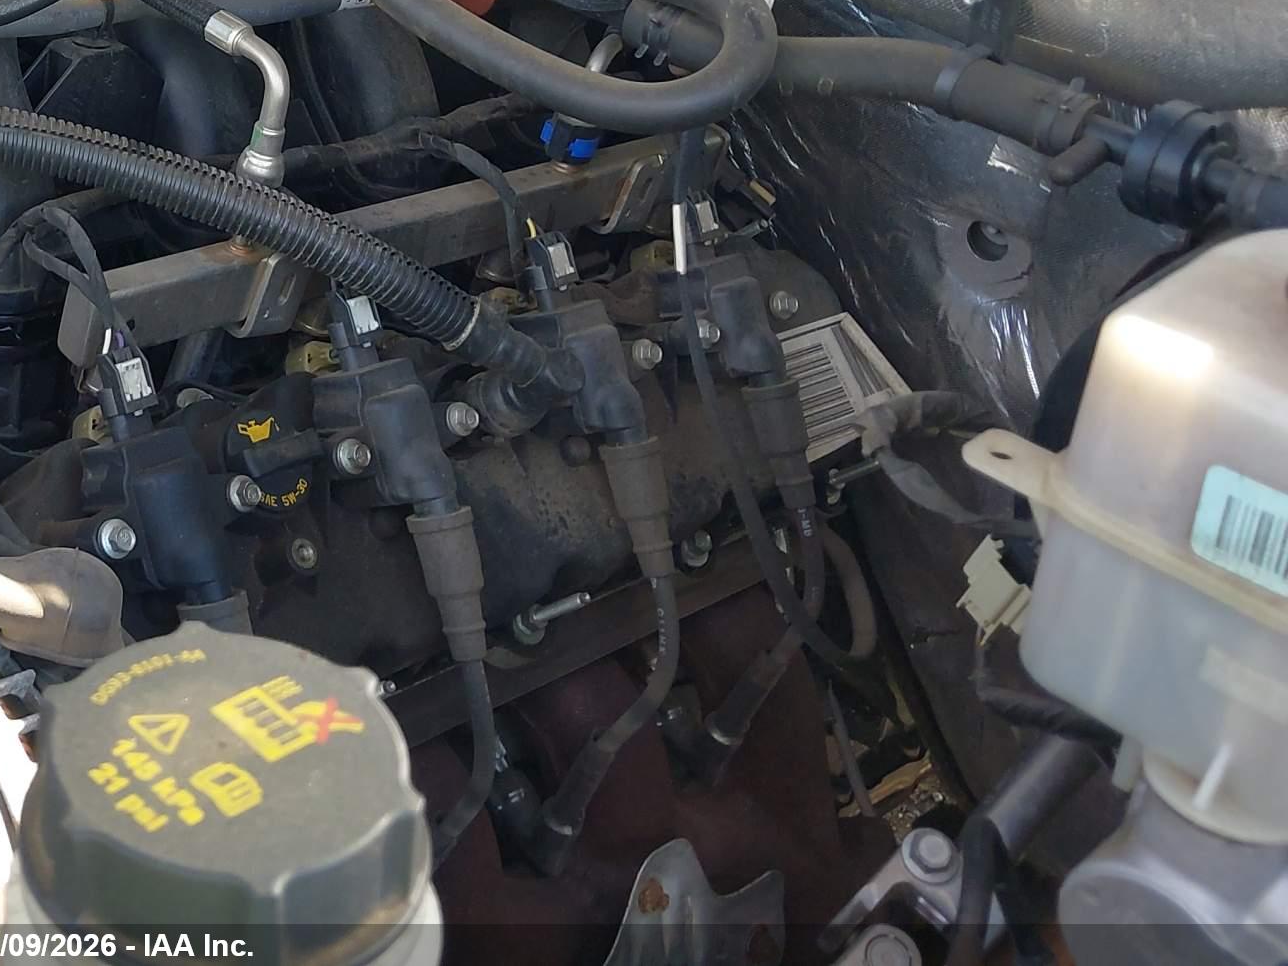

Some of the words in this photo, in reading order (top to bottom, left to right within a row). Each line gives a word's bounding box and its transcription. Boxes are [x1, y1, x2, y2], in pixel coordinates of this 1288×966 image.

[281, 478, 308, 507] 5W-30
[111, 737, 162, 781] 145
[88, 761, 130, 794] 21
